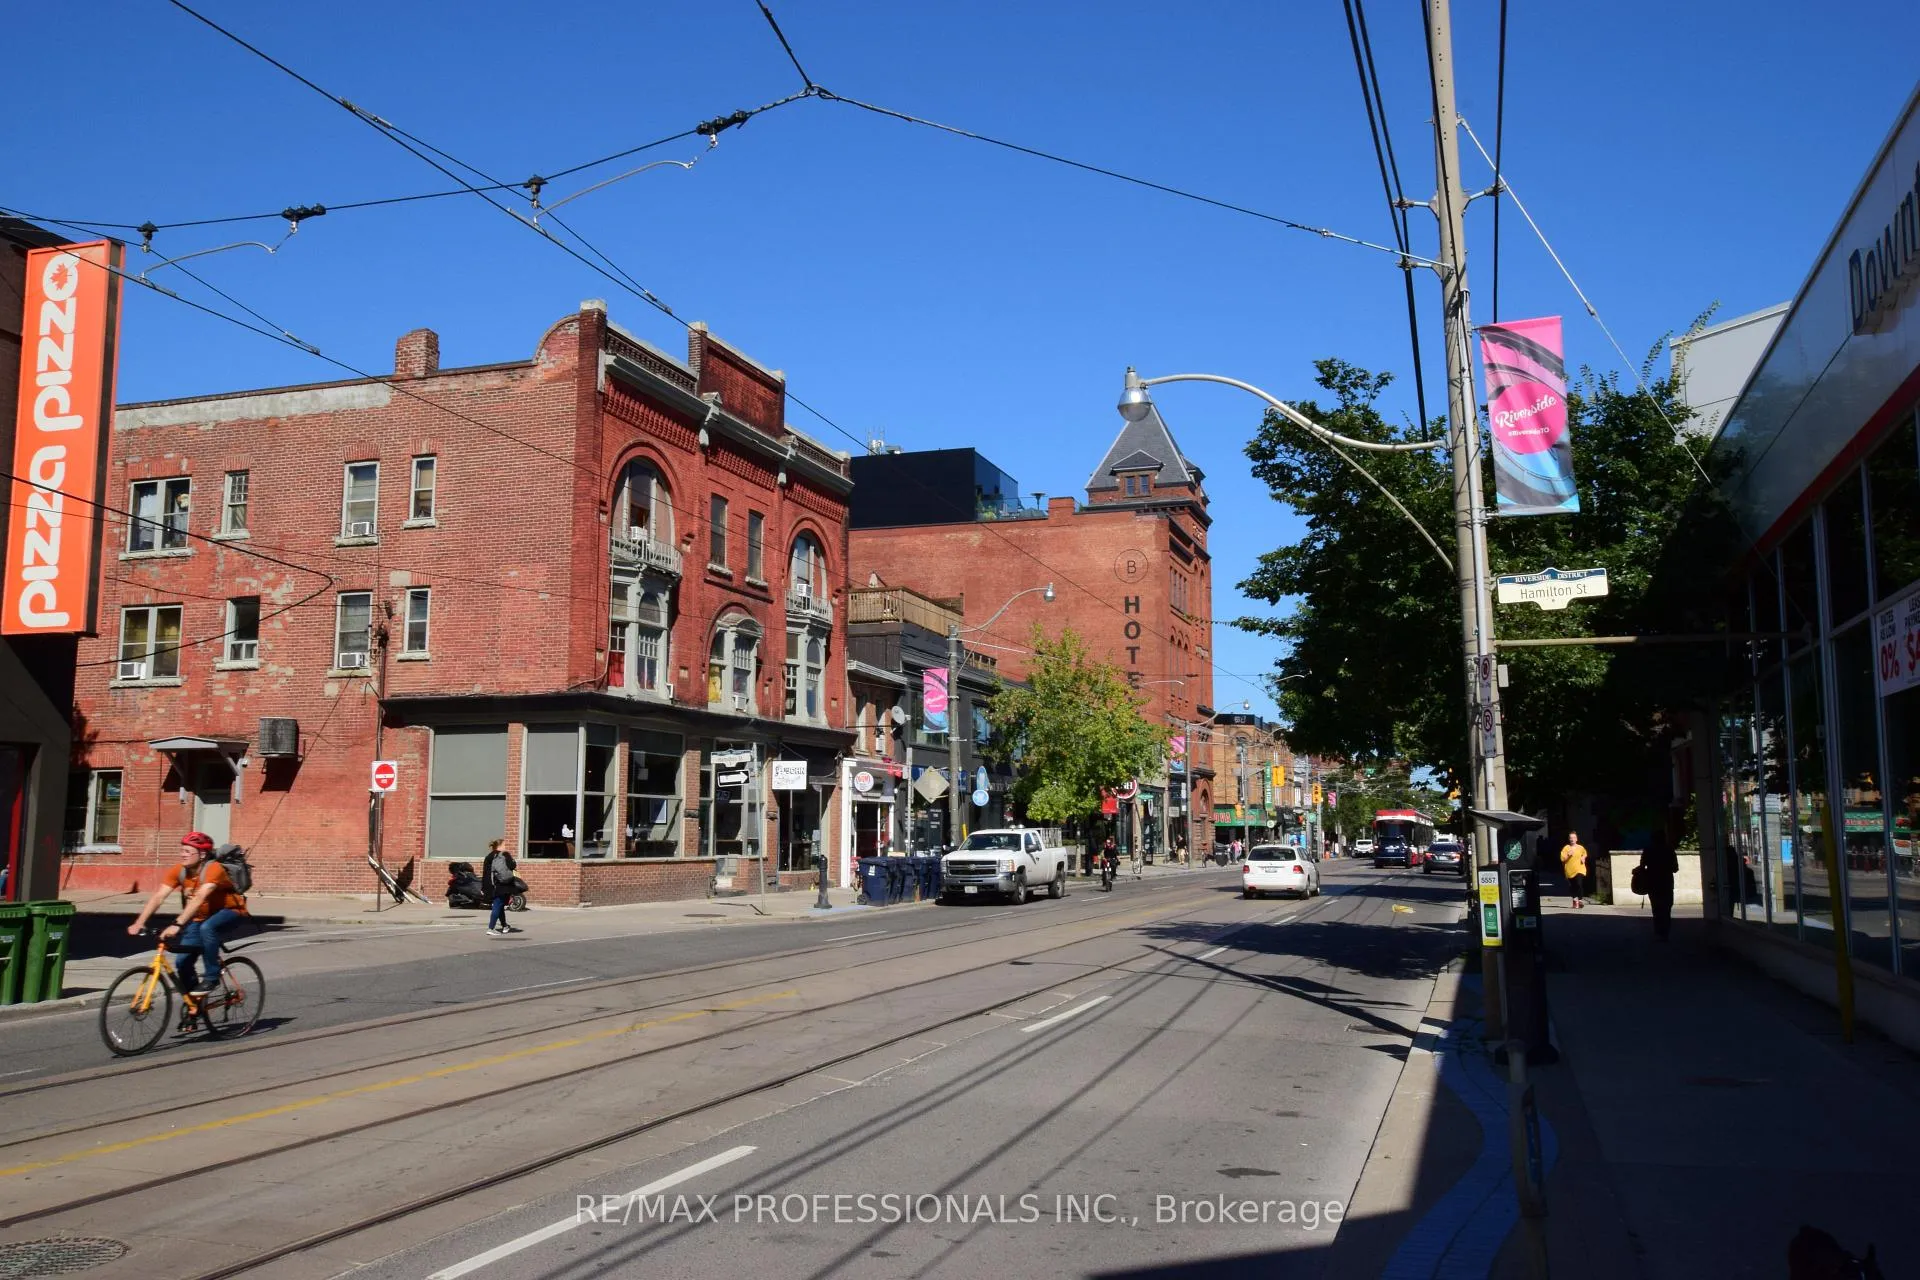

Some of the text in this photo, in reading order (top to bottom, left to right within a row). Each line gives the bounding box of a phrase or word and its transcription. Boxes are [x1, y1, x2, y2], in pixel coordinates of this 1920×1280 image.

[1495, 393, 1557, 428] Riverside
[19, 252, 84, 628] pizza pizza
[1515, 571, 1588, 584] RIVERSIDE DISTRICT
[1520, 583, 1587, 599] Hamilton St
[1124, 595, 1142, 702] HOTE
[1881, 639, 1900, 682] 0%
